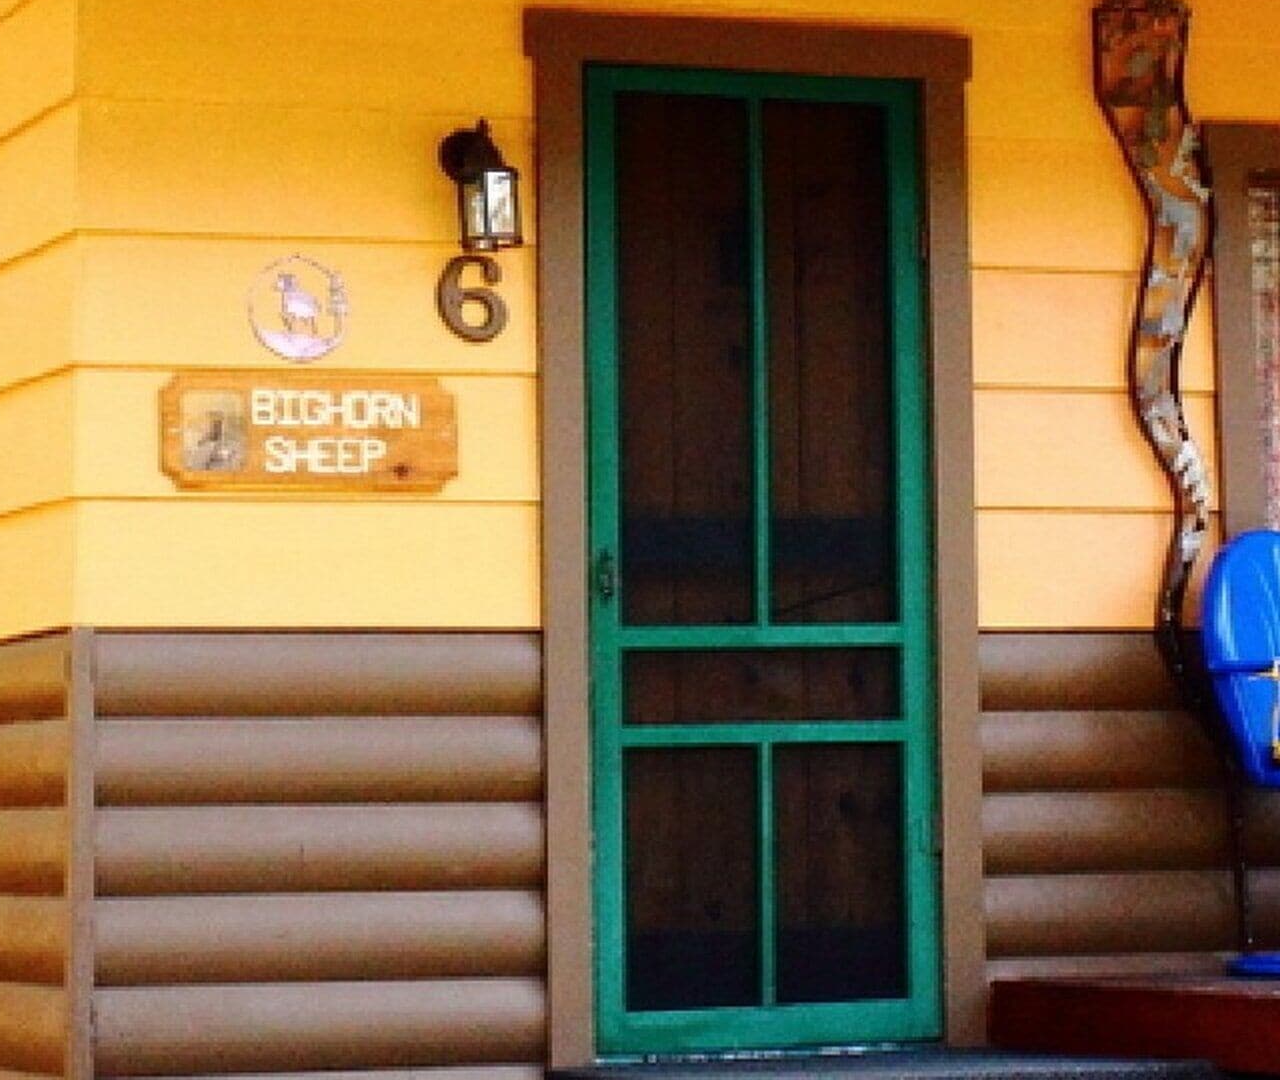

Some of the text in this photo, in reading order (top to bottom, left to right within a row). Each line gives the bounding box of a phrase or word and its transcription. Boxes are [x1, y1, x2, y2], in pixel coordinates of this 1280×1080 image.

[436, 254, 508, 342] 6
[251, 389, 417, 427] BIGHORN
[265, 436, 386, 472] SHEEP
